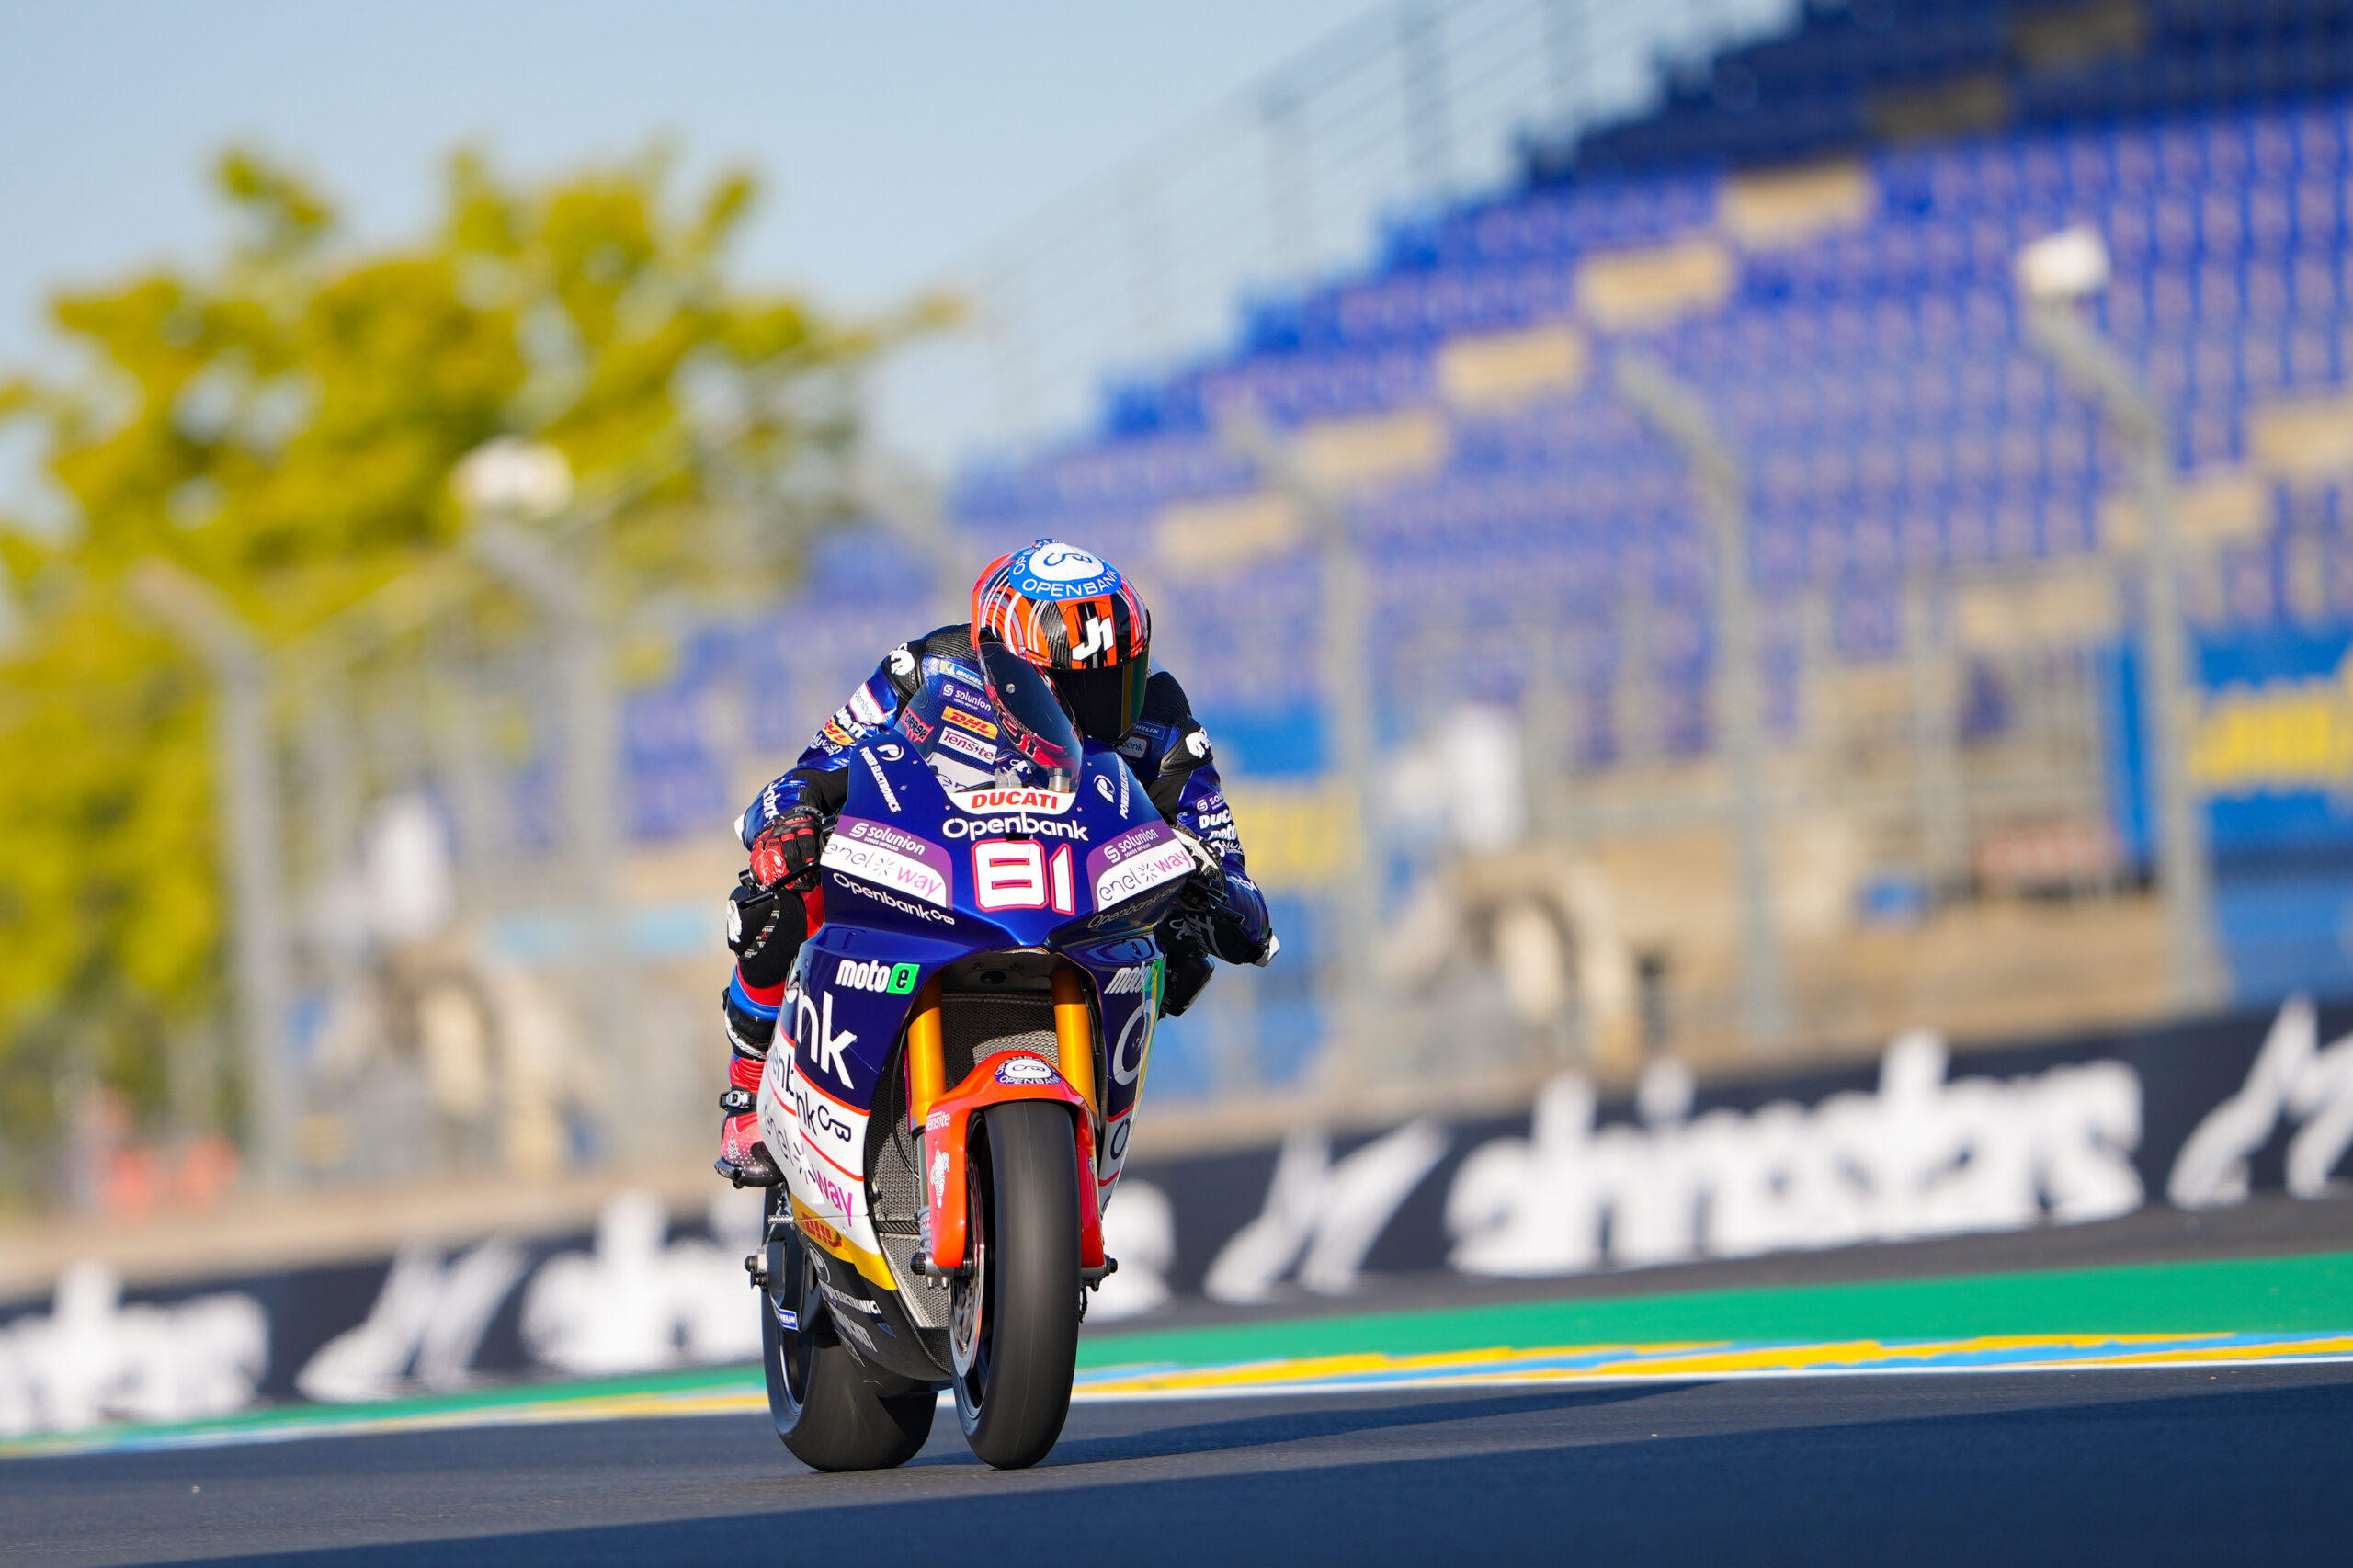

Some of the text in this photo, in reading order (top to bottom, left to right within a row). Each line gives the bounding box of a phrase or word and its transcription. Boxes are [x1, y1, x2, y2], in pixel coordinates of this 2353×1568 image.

[1022, 567, 1118, 597] OPENBANK
[956, 669, 983, 686] MICHEL
[955, 689, 992, 712] solunion
[949, 711, 992, 734] DHL
[972, 791, 1059, 810] DUCATI
[867, 824, 926, 856] solunion
[942, 812, 1089, 842] Openbank
[1118, 828, 1159, 852] solunion
[824, 842, 943, 898] enel way
[972, 838, 1076, 915] 81
[1099, 850, 1192, 901] enel way
[833, 872, 932, 922] Openbank
